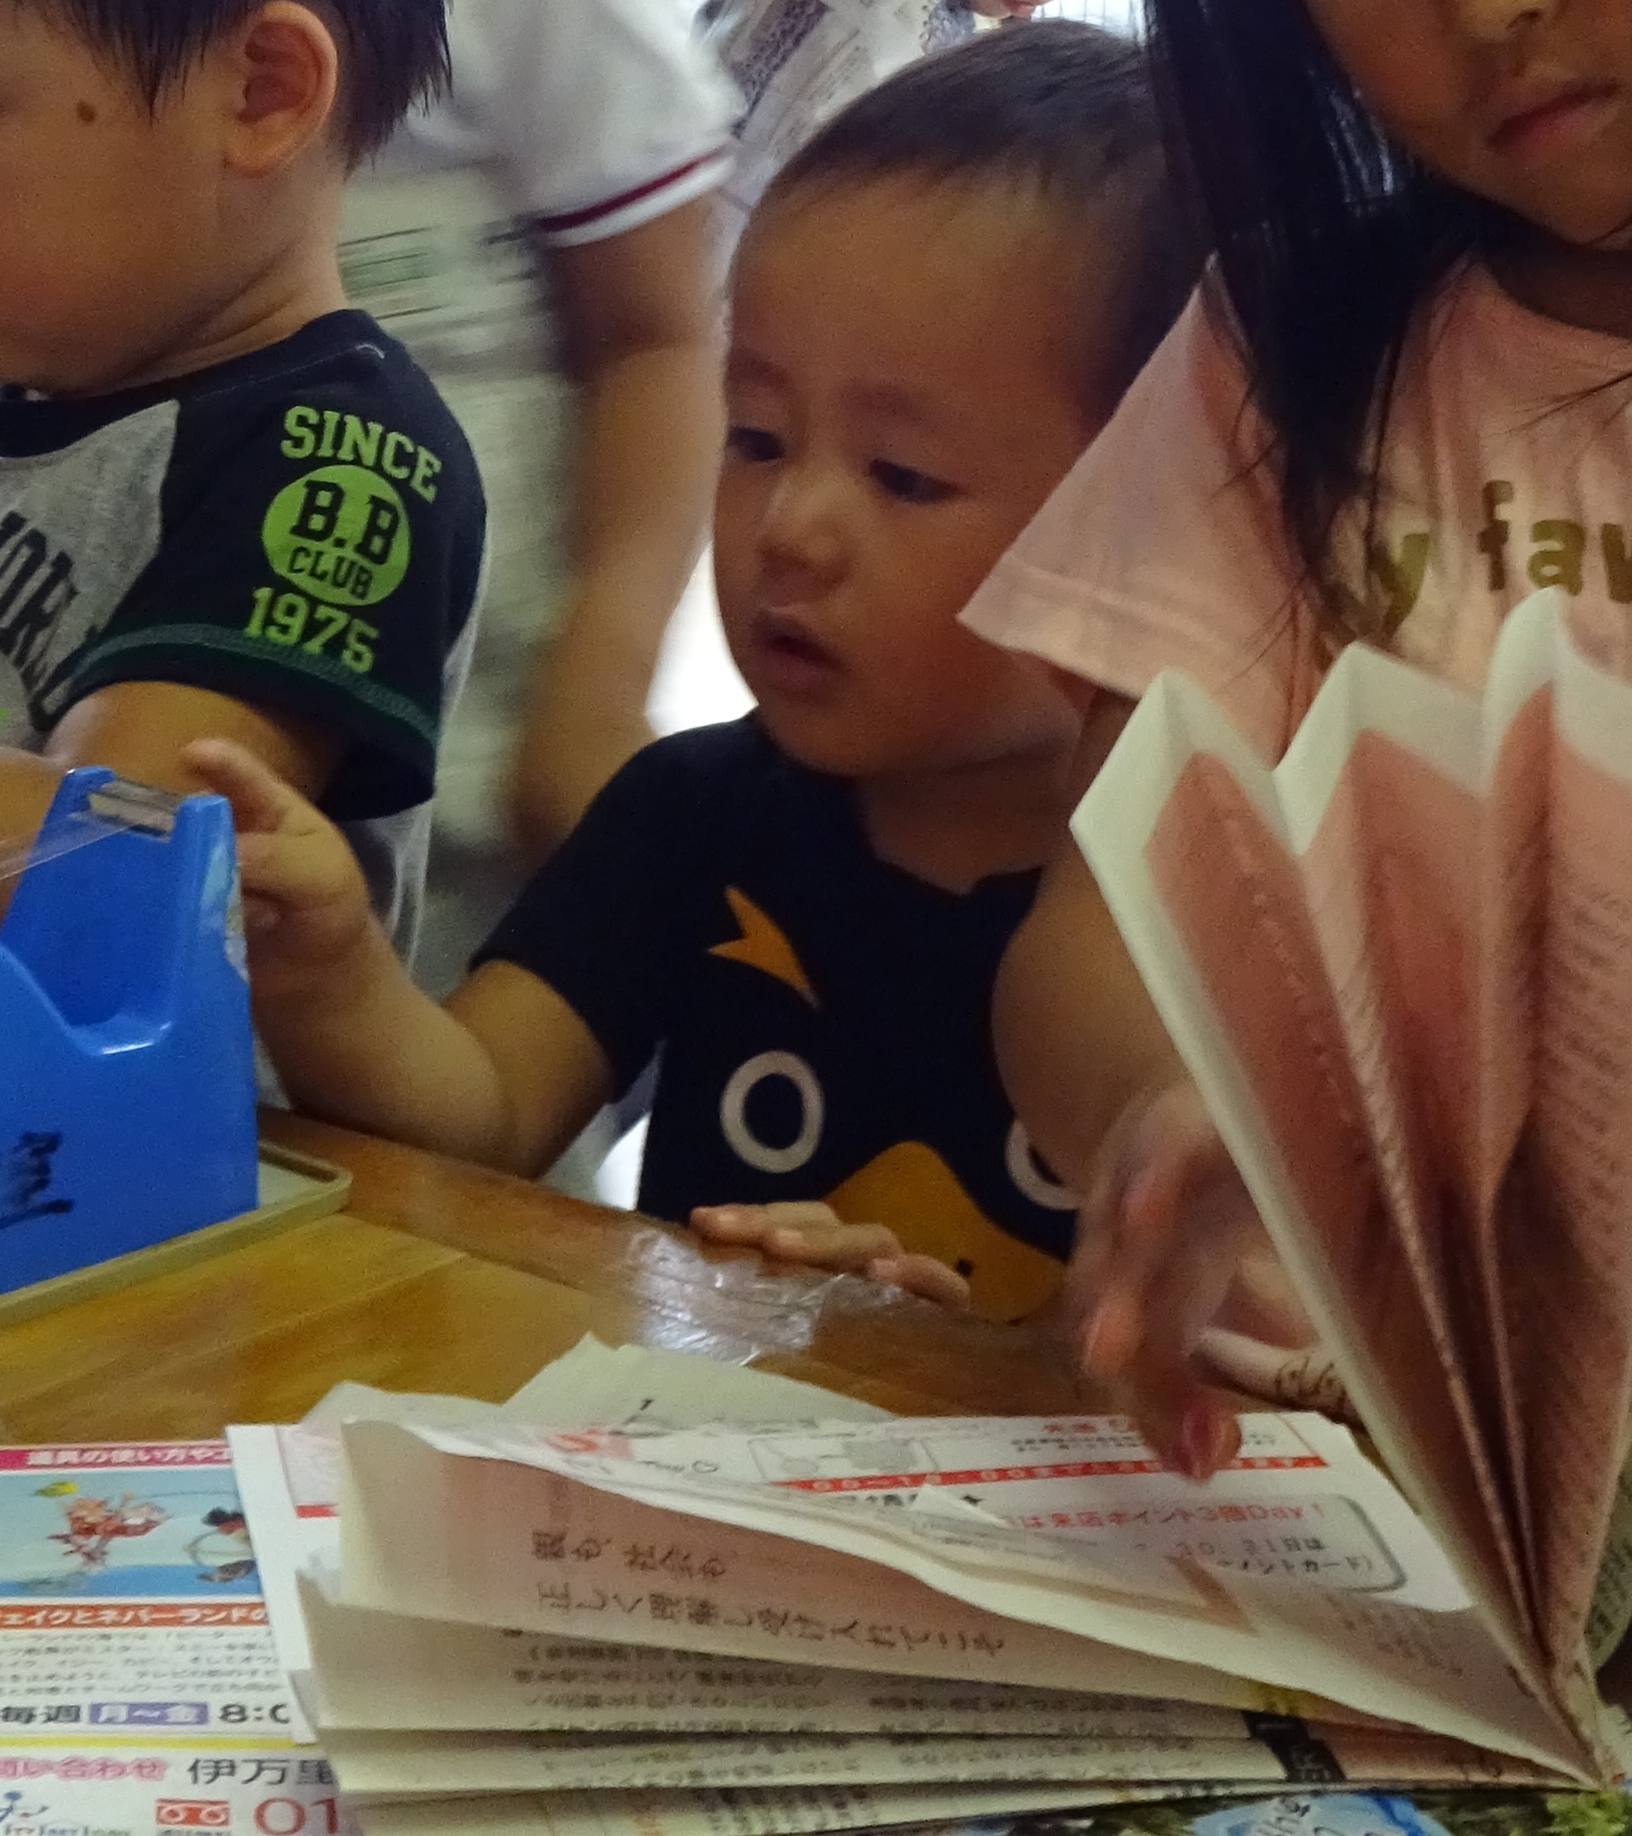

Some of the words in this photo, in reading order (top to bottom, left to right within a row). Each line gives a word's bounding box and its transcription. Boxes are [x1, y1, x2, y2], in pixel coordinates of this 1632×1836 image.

[280, 405, 443, 504] SINCE
[289, 479, 400, 566] B.B
[287, 546, 374, 600] CLUB
[244, 587, 380, 673] 1975
[0, 1705, 81, 1724] 毎週
